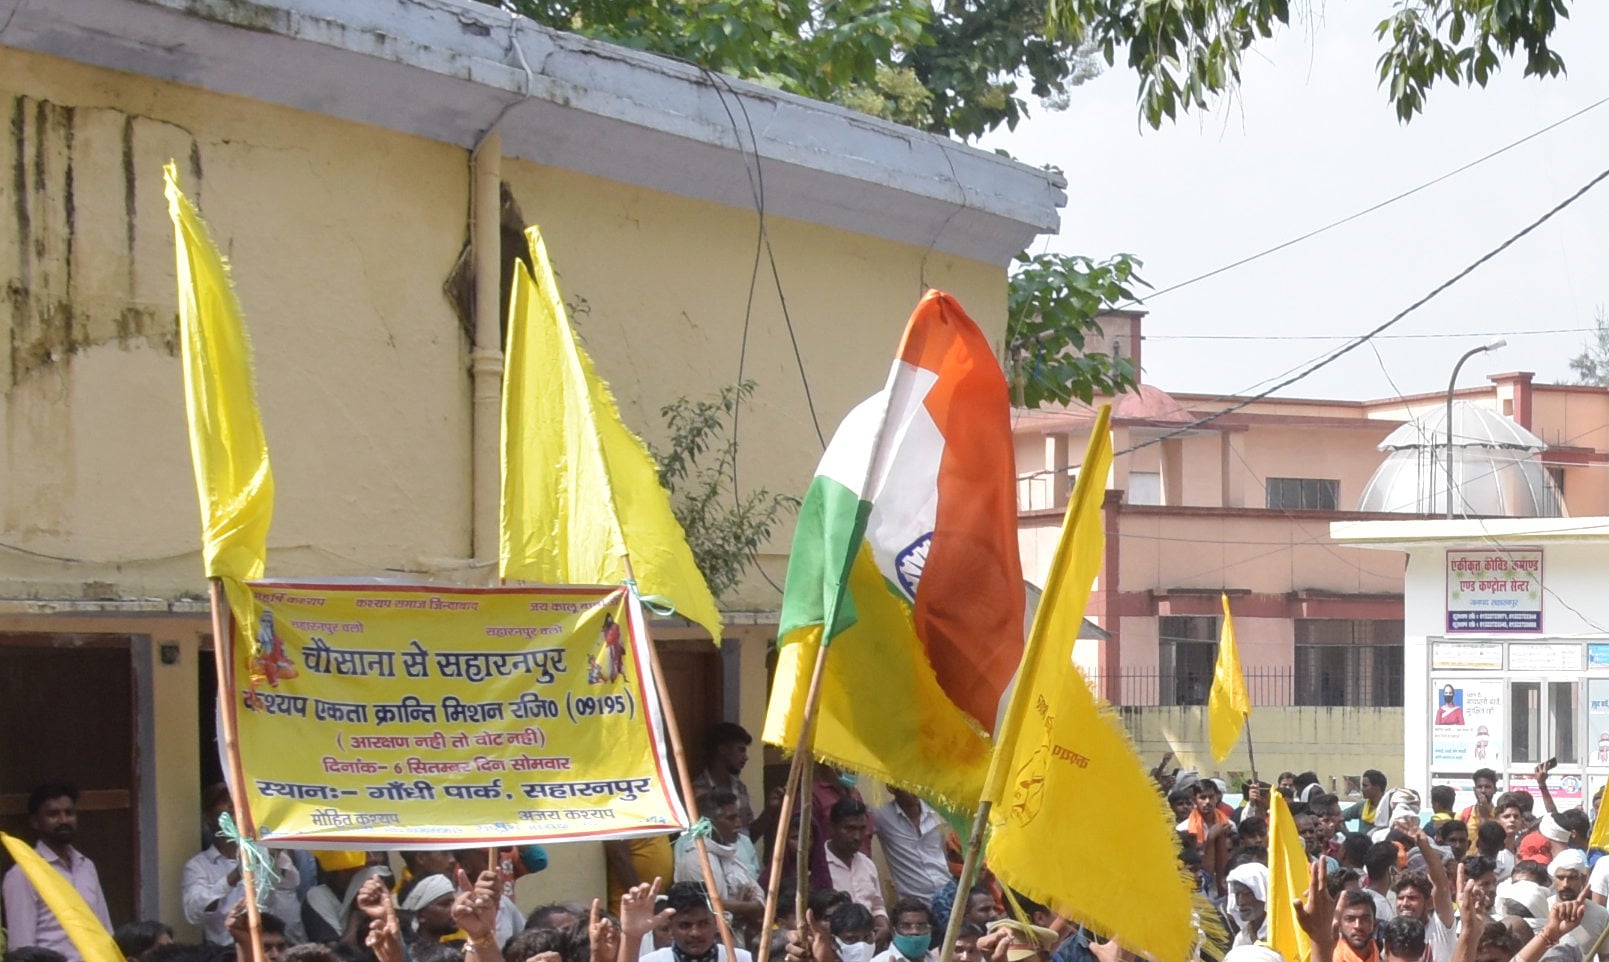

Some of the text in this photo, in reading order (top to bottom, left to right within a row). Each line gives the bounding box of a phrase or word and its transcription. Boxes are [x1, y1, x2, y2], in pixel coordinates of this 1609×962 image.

[1484, 557, 1508, 571] कोविड
[1460, 580, 1476, 592] एण्ड
[1511, 578, 1529, 592] सेन्टर
[302, 637, 568, 684] चौसाना से सहारनपुर
[314, 699, 368, 723] एकता
[373, 696, 437, 726] क्रान्ति
[442, 695, 504, 723] मिशन
[452, 732, 469, 748] तो
[474, 731, 503, 746] वोट
[394, 762, 403, 774] 6
[511, 754, 571, 770] सोमवार
[520, 777, 651, 801] सहारनपुर
[310, 809, 353, 828] मोहित
[518, 808, 616, 821] अजय कश्यप
